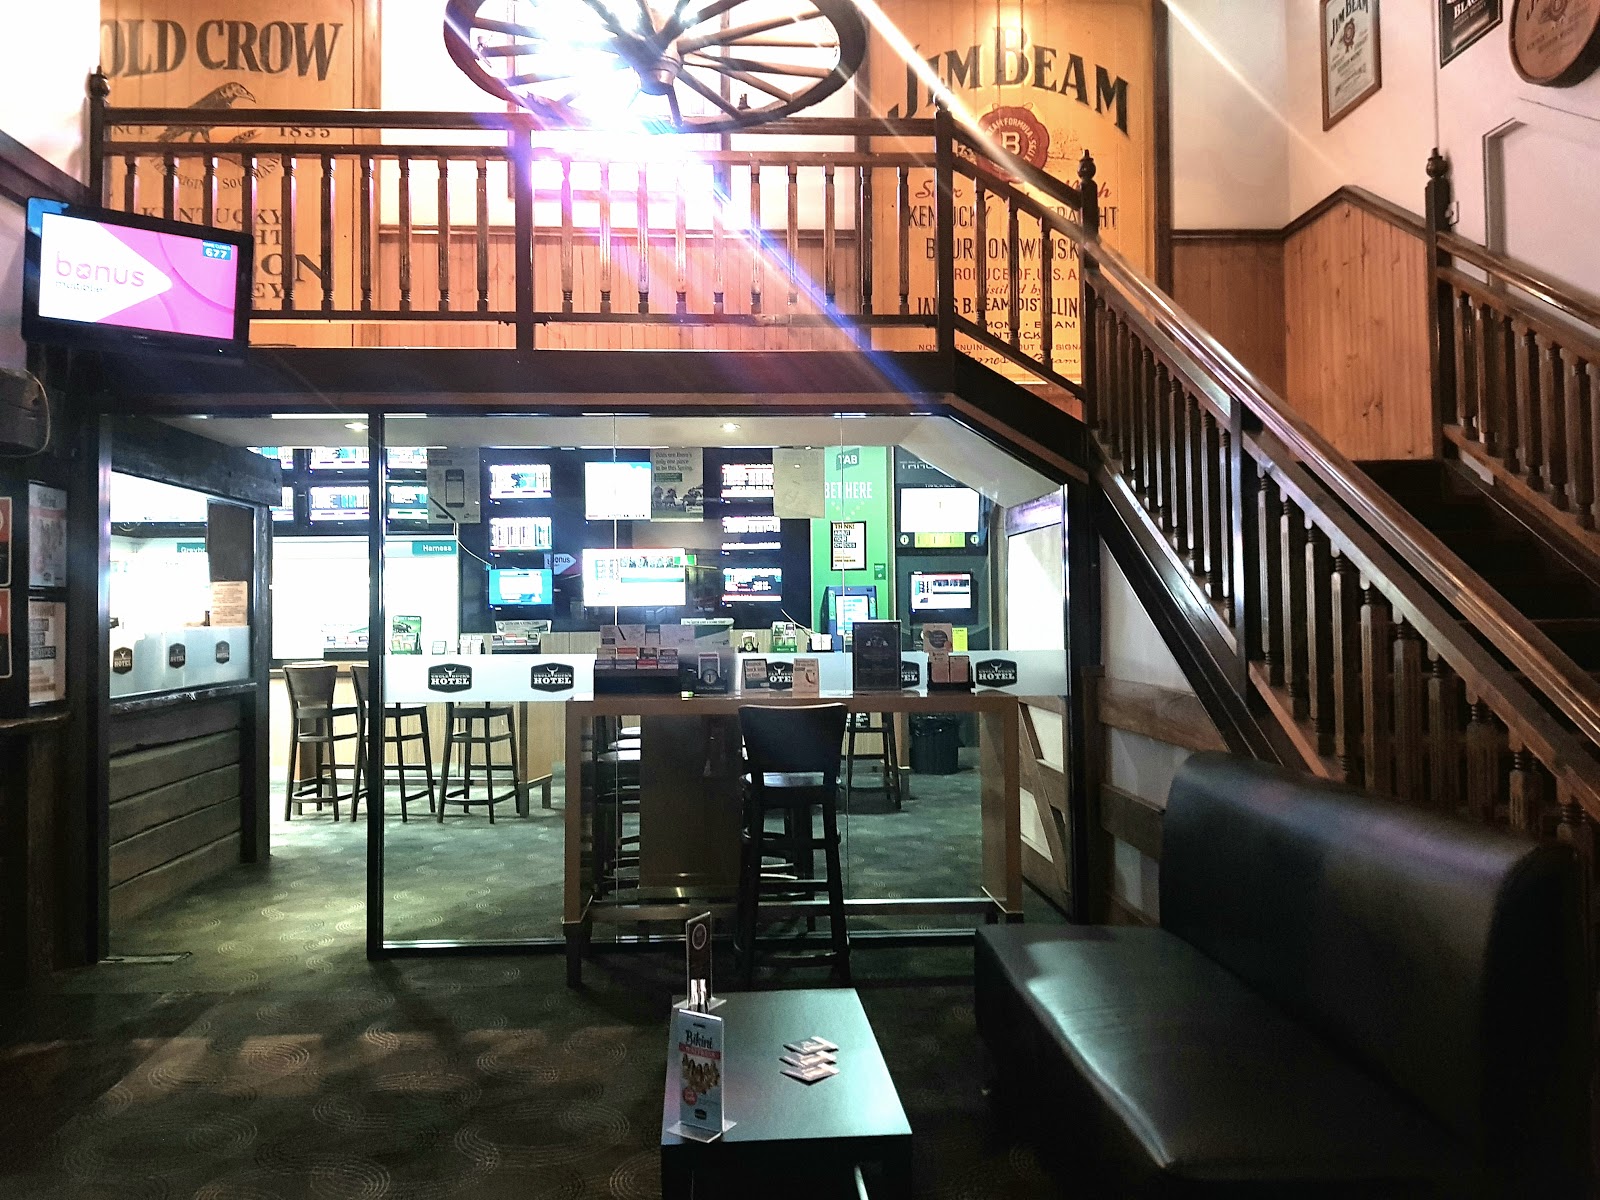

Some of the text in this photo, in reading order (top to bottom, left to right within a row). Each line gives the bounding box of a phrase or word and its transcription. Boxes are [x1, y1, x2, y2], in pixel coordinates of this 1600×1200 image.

[100, 18, 344, 82] OLD CROW
[887, 25, 1130, 138] JIM BEAM
[278, 126, 331, 138] 1835
[1003, 117, 1034, 139] FORMULA
[205, 249, 228, 260] 677
[56, 250, 145, 288] bonus
[837, 454, 858, 465] TAB
[825, 481, 872, 499] BET HERE
[533, 677, 572, 685] HOTEL
[978, 673, 1015, 681] HOTEL
[685, 1029, 713, 1049] Bikini
